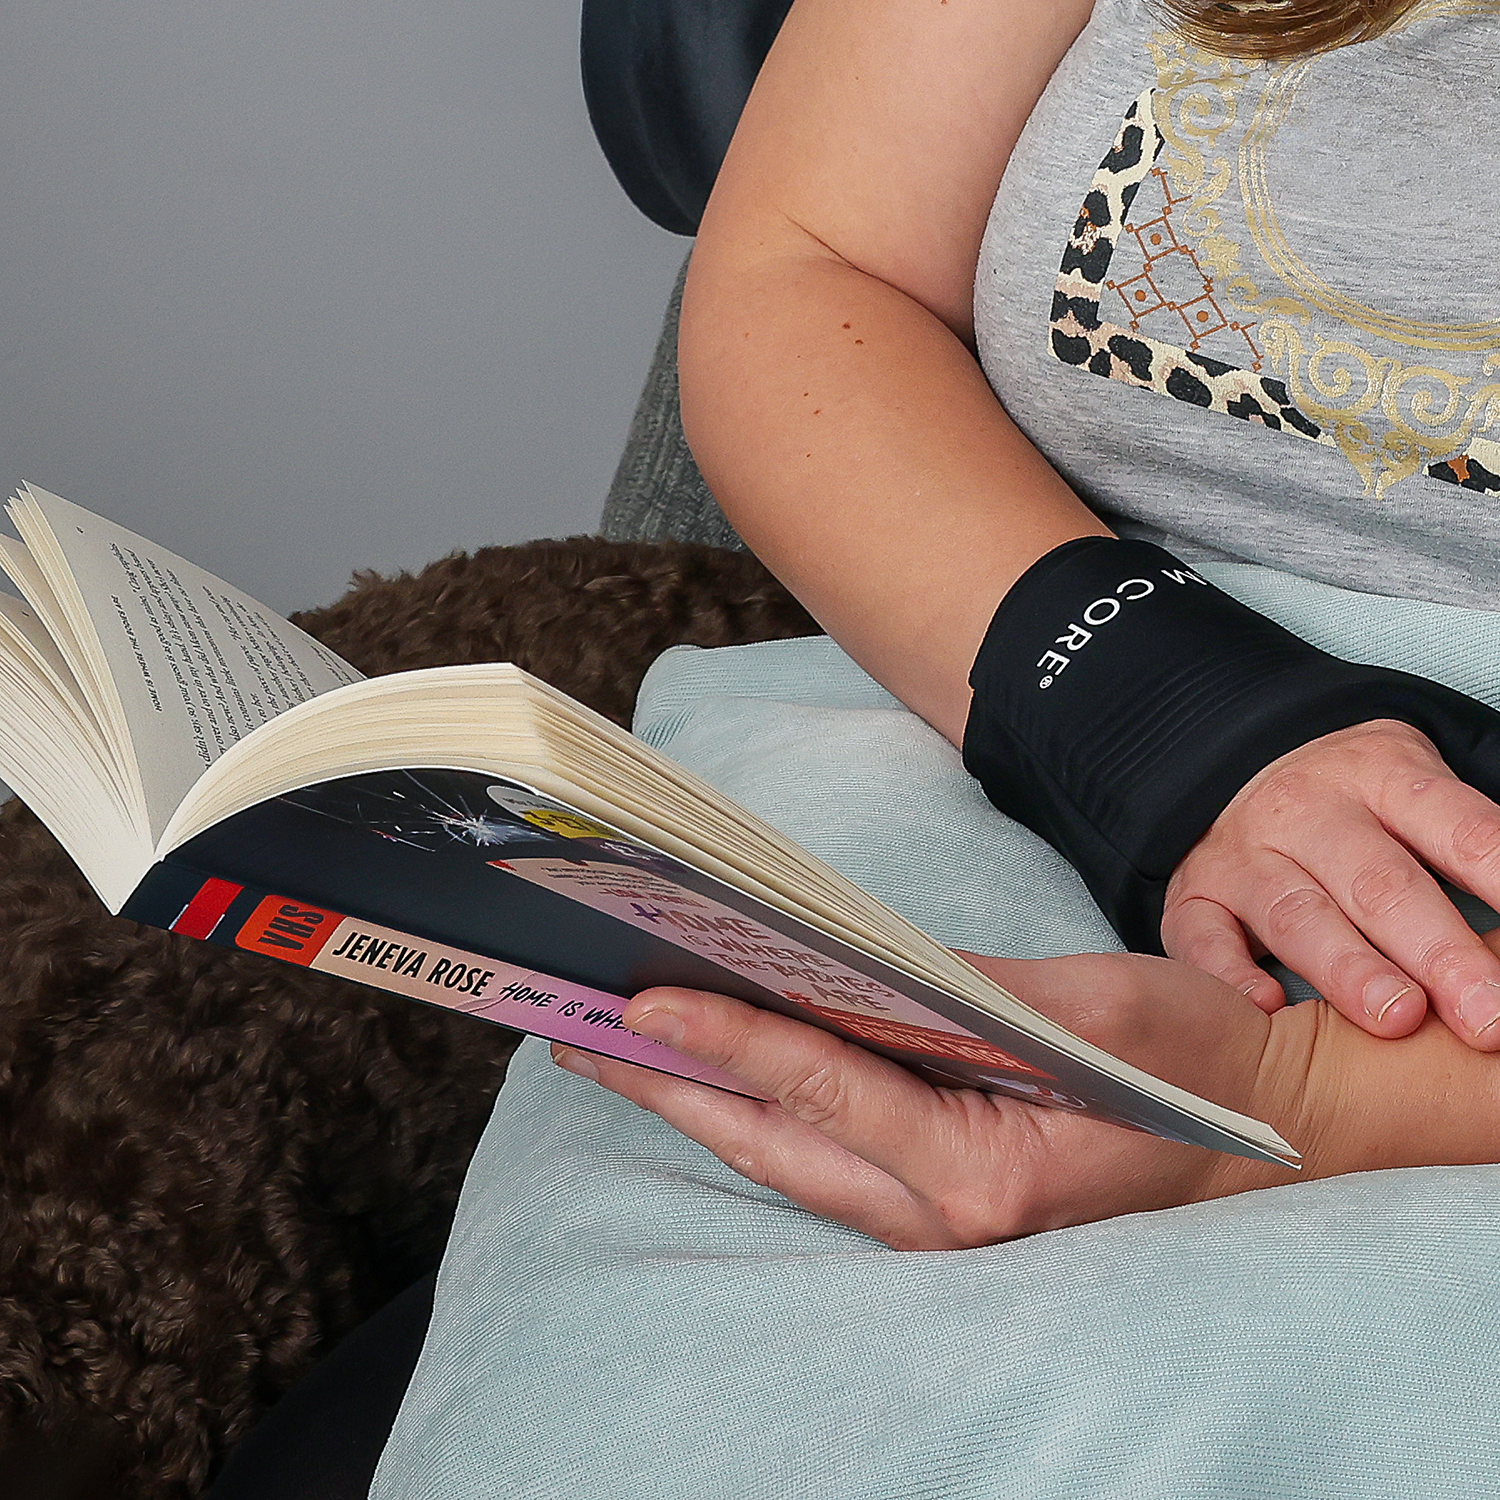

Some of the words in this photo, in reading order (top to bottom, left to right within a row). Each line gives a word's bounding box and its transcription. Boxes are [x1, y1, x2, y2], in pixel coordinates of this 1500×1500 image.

[118, 610, 134, 636] BODIES
[150, 623, 171, 646] good
[135, 651, 150, 677] WHERE
[194, 650, 210, 664] did
[170, 662, 188, 686] guess
[204, 665, 218, 684] what
[148, 688, 162, 711] HOME
[179, 685, 196, 708] your
[210, 683, 227, 704] And
[231, 687, 251, 722] contains
[201, 706, 219, 726] and
[209, 725, 224, 747] over
[258, 904, 326, 951] VHS
[629, 902, 772, 940] HOME
[331, 931, 424, 977] JENEVA
[427, 962, 496, 999] ROSE
[708, 936, 836, 970] WHERE
[708, 953, 768, 972] THE
[763, 960, 896, 998] BODIES
[500, 982, 558, 1008] HOME
[557, 1000, 585, 1017] IS
[582, 1007, 642, 1037] WHE
[810, 983, 892, 1012] ARE
